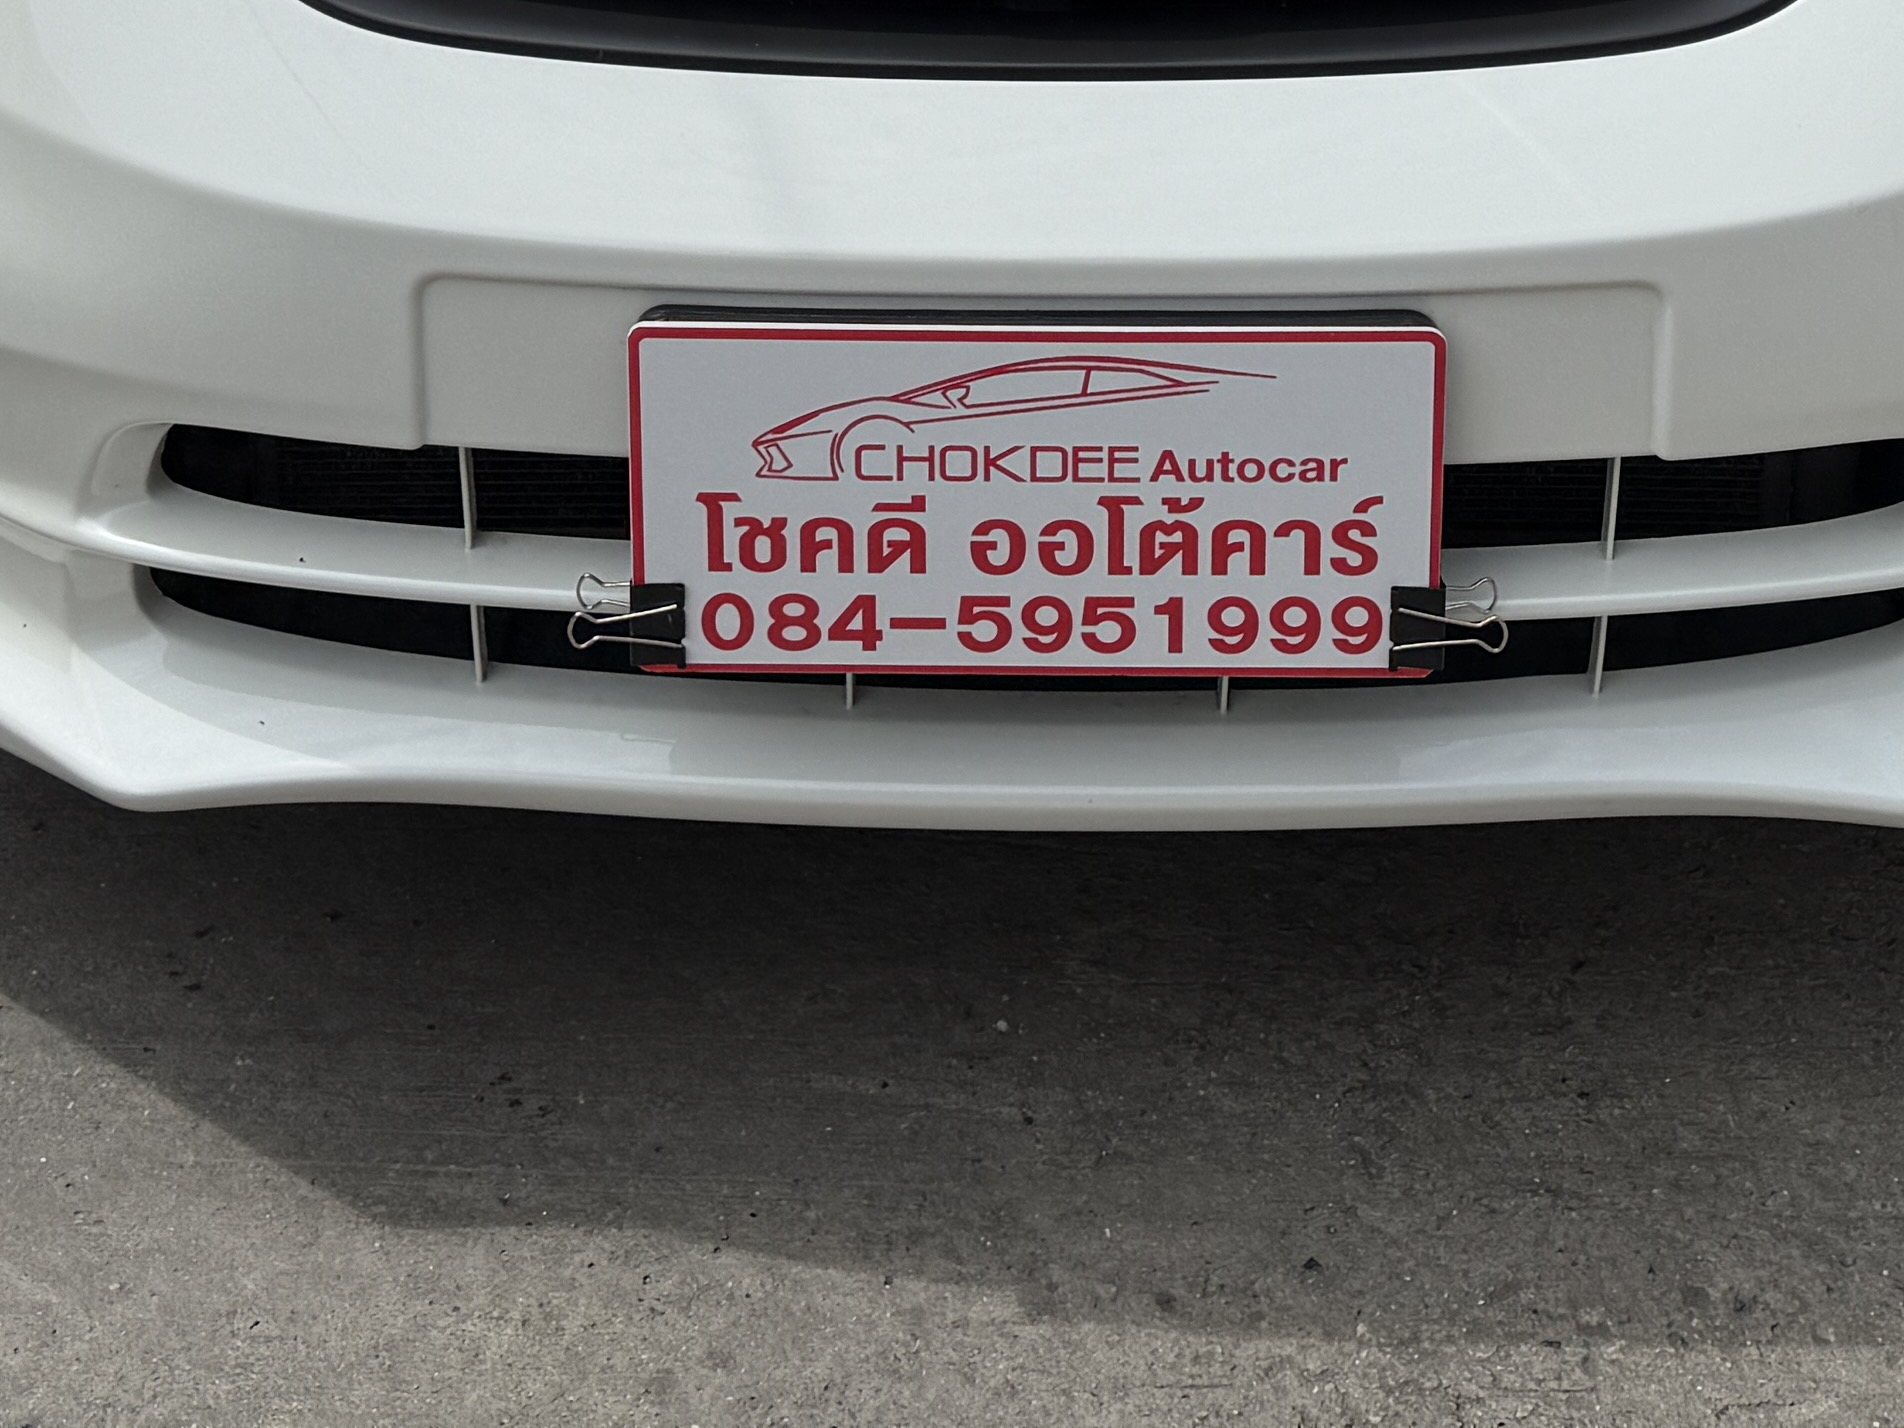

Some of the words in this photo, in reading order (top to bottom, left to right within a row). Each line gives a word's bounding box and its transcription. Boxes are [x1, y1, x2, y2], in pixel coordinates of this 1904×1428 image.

[854, 444, 1141, 483] CHOKDEE
[1149, 449, 1348, 483] Autocar
[696, 491, 927, 575] โชคดี
[969, 494, 1385, 576] ออโต้คาร์
[700, 592, 1384, 654] 084-5951999
